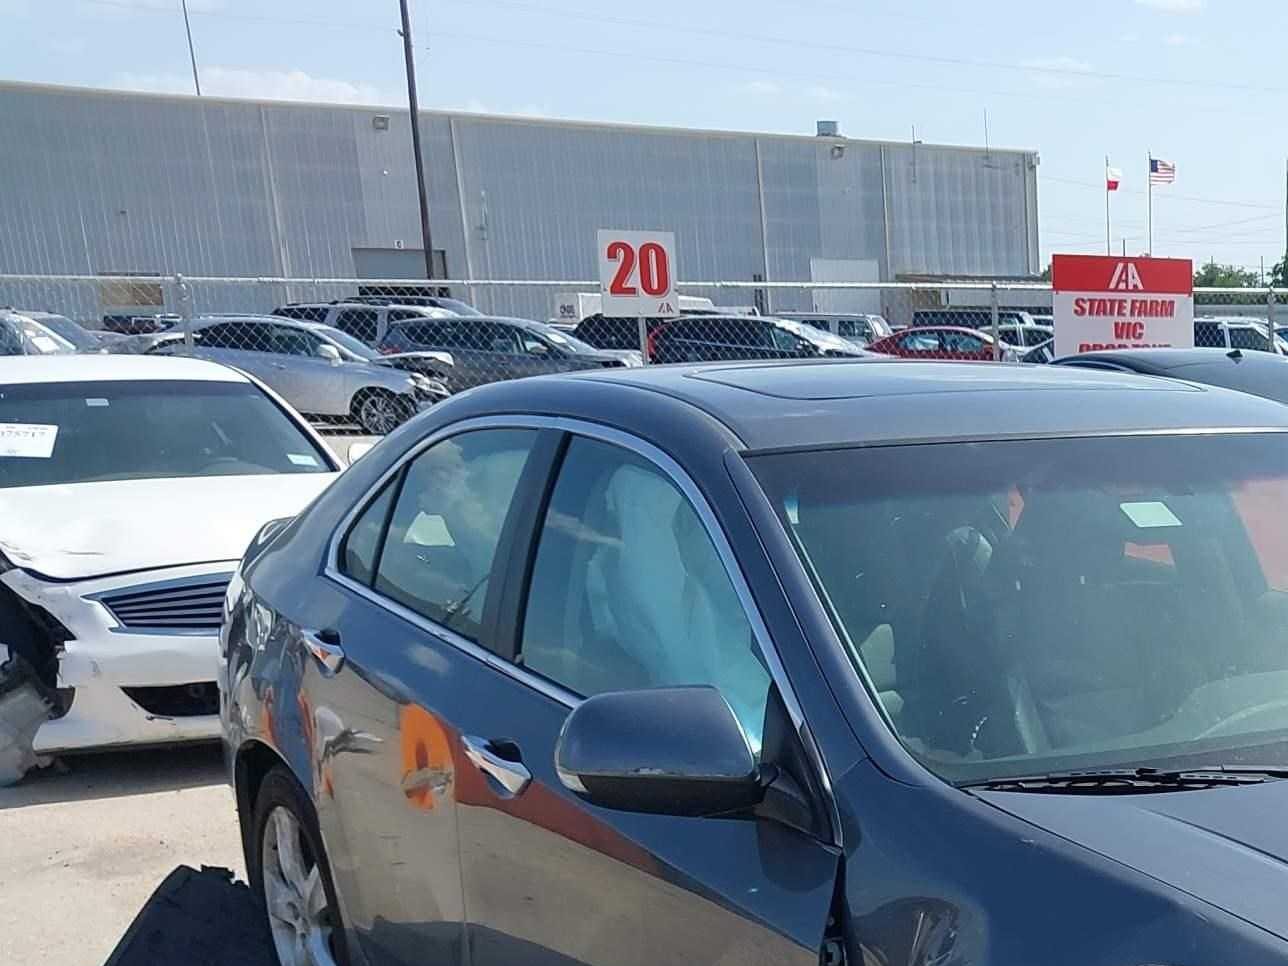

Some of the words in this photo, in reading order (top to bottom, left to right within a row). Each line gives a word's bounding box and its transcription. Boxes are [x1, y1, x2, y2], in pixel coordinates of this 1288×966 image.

[607, 241, 669, 296] 20
[1073, 298, 1127, 317] STATE
[1129, 299, 1175, 318] FARM
[1113, 321, 1145, 340] VIC
